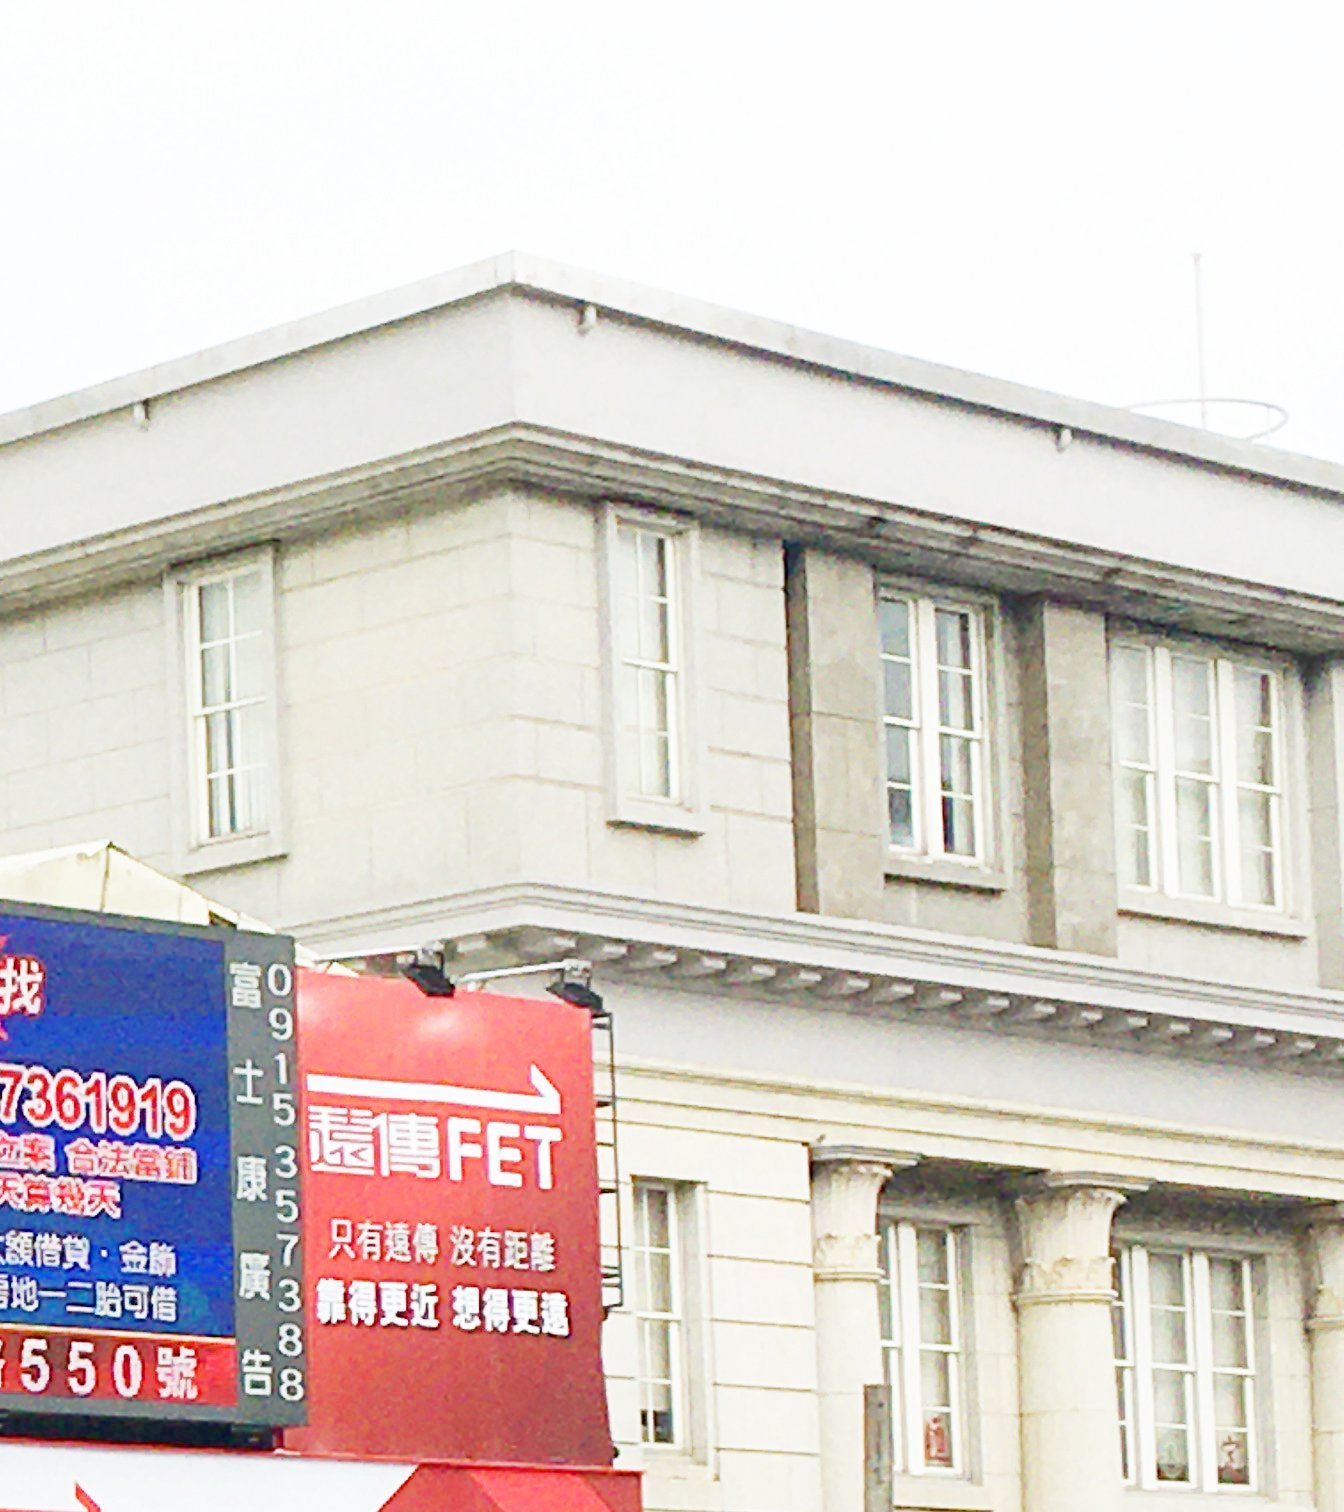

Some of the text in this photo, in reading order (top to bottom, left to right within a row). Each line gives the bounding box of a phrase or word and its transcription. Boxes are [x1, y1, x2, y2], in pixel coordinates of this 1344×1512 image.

[446, 1115, 563, 1190] FET
[328, 1218, 557, 1272] 只有遠傳 沒有距離
[315, 1277, 570, 1337] 靠得更近 想得更遠
